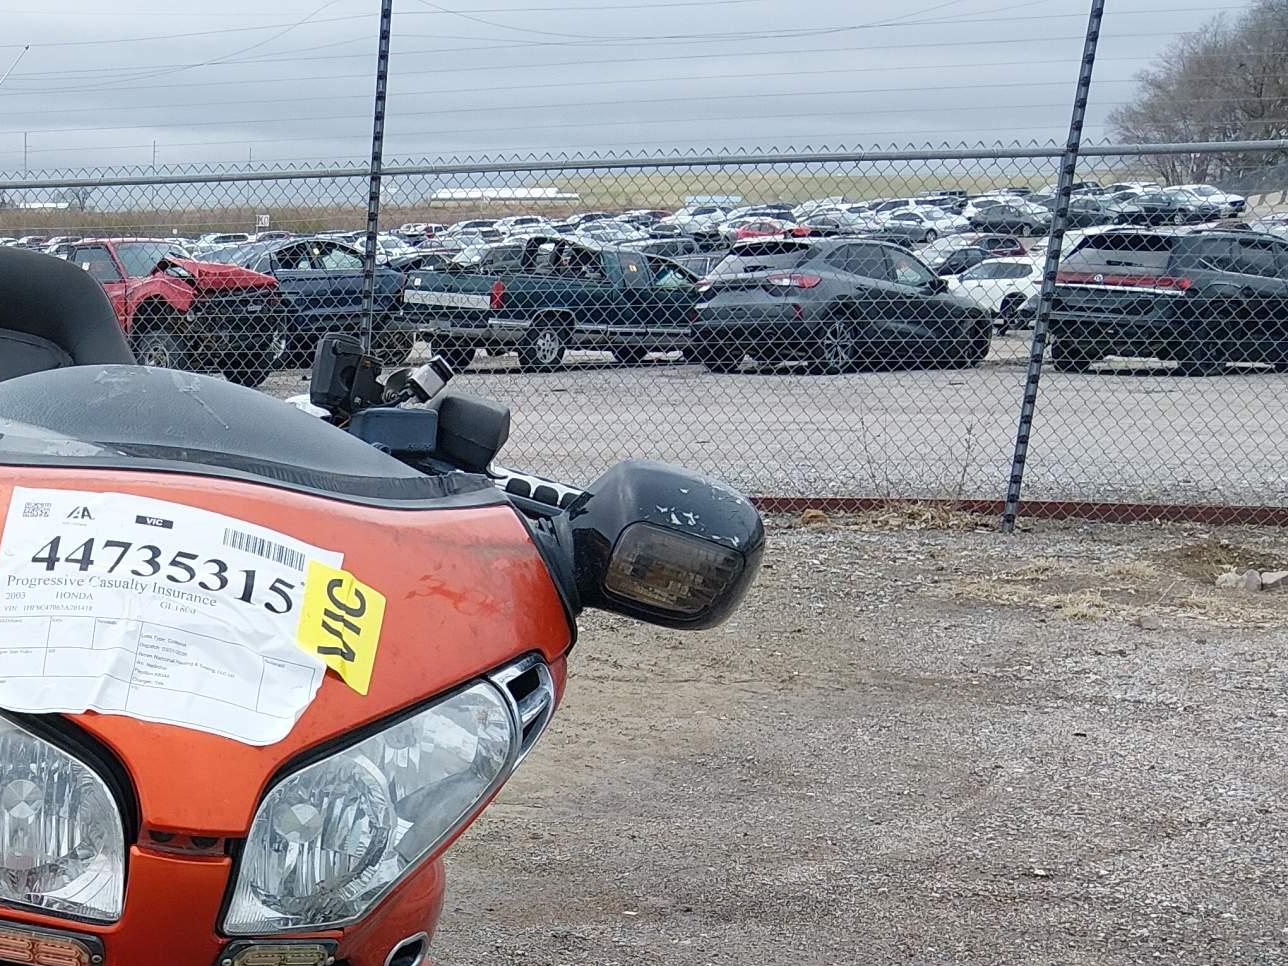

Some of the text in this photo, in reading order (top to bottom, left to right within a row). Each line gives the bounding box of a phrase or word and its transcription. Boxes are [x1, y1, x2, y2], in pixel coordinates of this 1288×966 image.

[146, 517, 164, 527] VIC
[7, 574, 218, 607] Progressive Casualty Insurance
[31, 535, 295, 614] 44735315
[5, 591, 94, 601] 2003 HONDA
[317, 579, 366, 663] VIC
